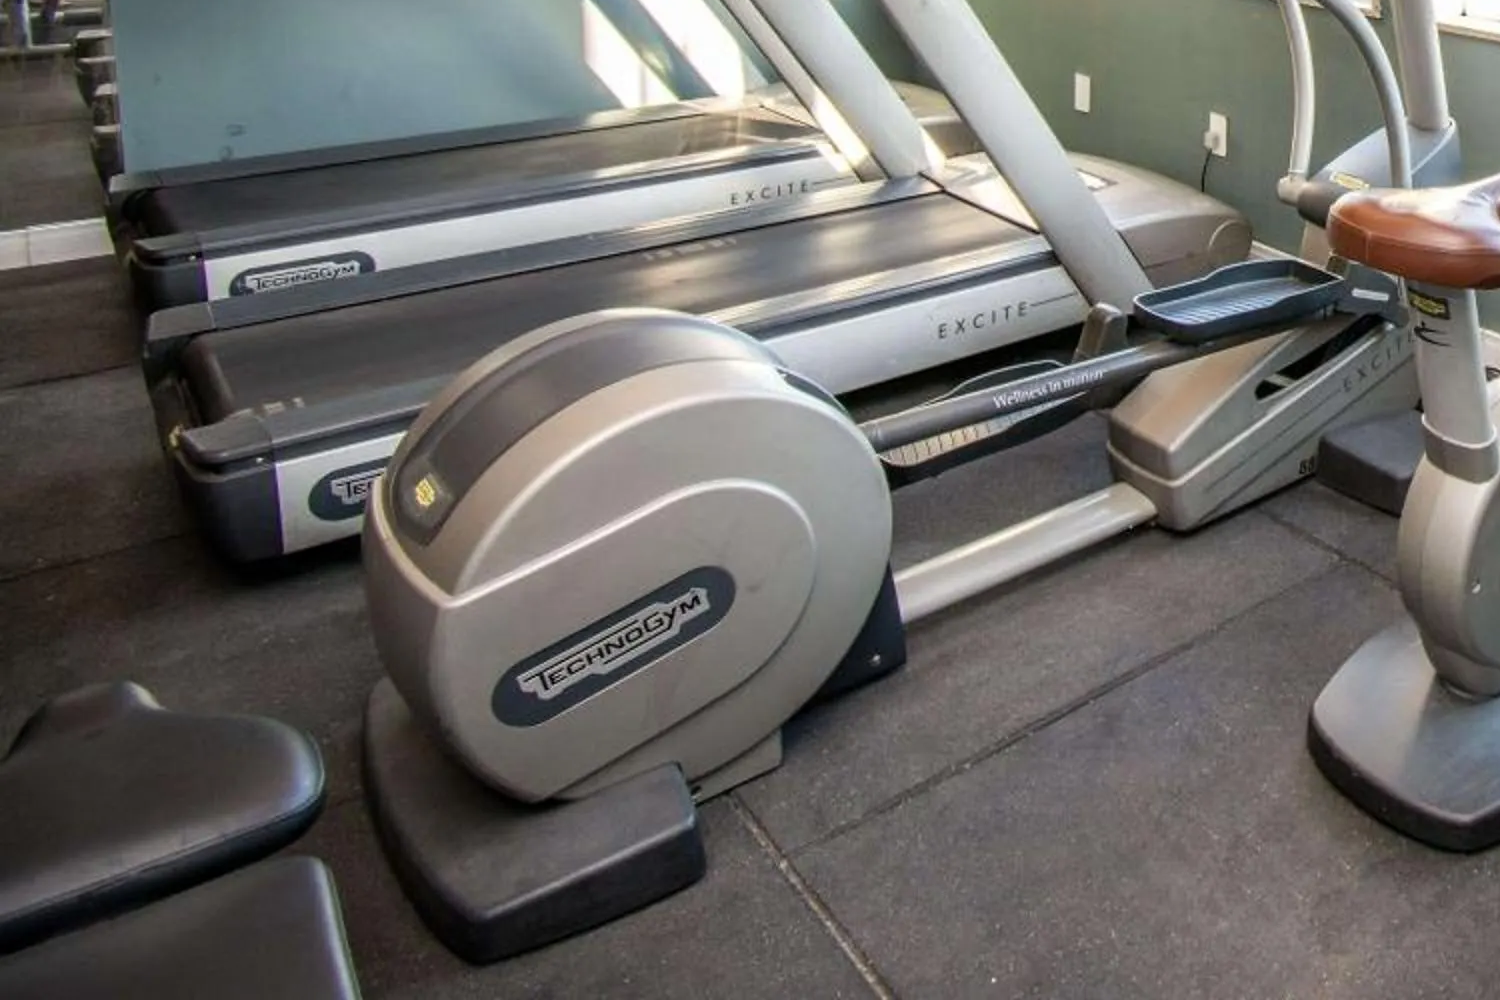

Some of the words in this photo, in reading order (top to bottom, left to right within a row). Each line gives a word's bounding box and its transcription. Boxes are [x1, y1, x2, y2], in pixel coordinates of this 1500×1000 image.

[729, 180, 808, 205] EXCITE
[938, 301, 1028, 339] EXCITE
[522, 595, 702, 691] TECHNOGYM
